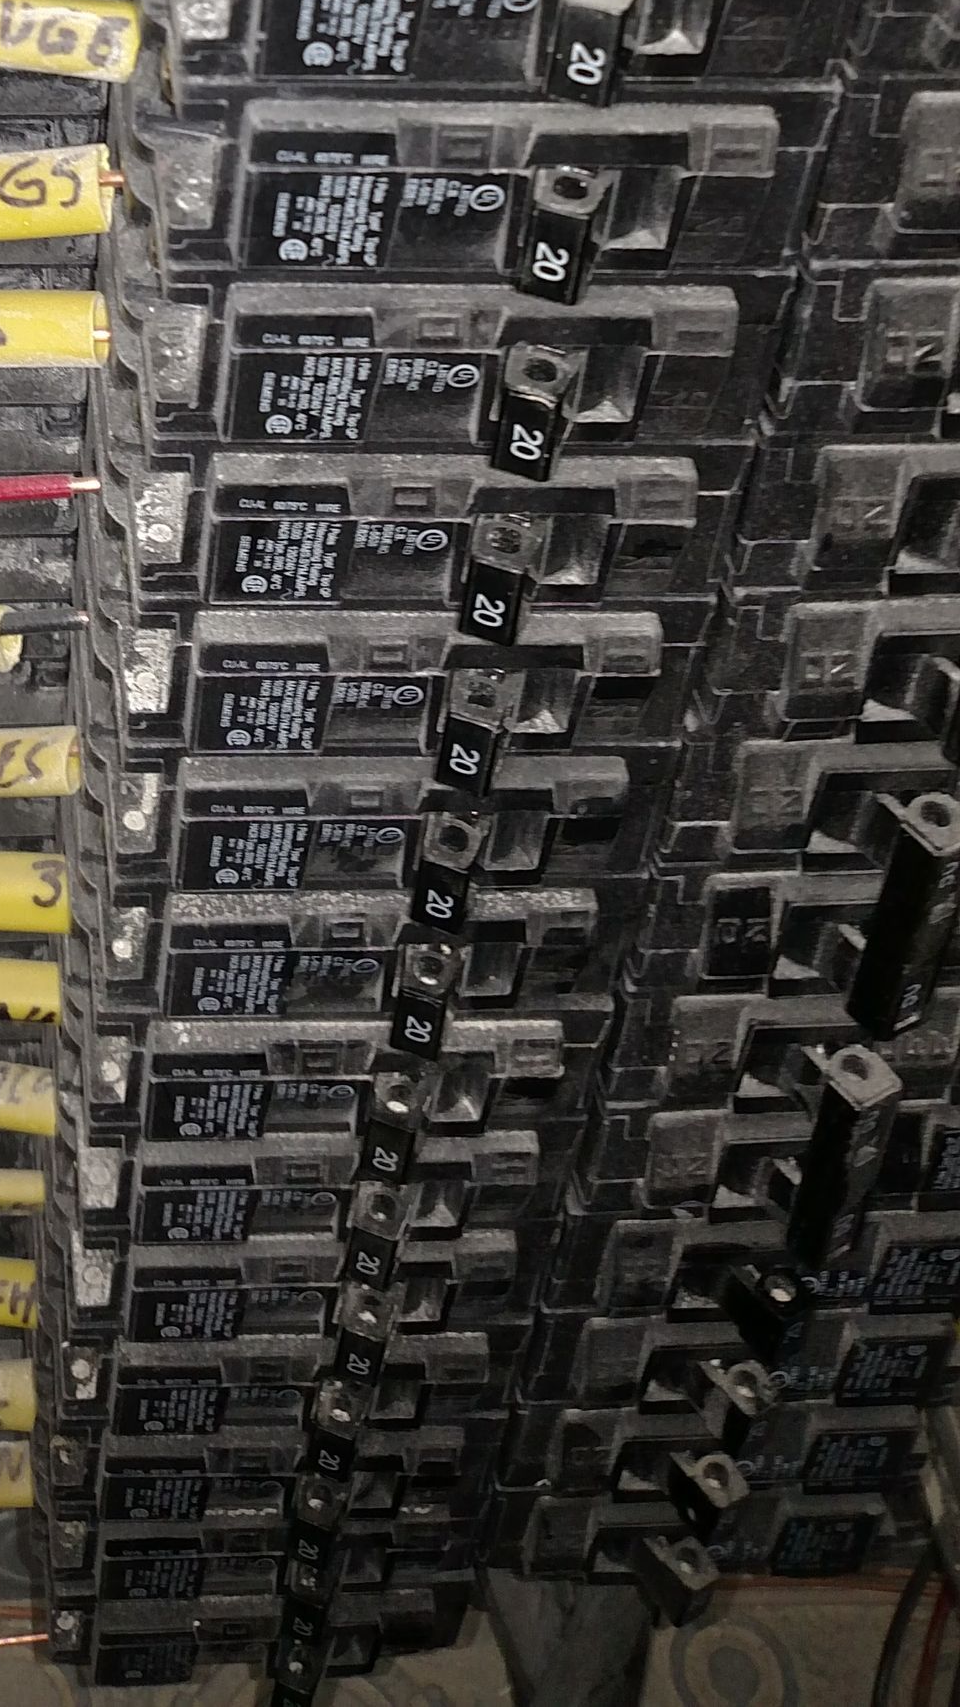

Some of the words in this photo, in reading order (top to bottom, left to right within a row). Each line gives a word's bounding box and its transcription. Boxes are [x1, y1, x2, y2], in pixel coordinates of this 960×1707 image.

[566, 41, 608, 86] 20
[532, 240, 571, 283] 20
[509, 422, 547, 463] 20
[471, 592, 508, 629] 20
[447, 741, 482, 778] 20
[32, 861, 65, 908] 3
[424, 887, 456, 920] 20
[404, 1013, 434, 1045] 20
[372, 1147, 402, 1174] 20
[356, 1250, 383, 1277] 20
[345, 1351, 372, 1377] 20
[317, 1448, 342, 1473] 20
